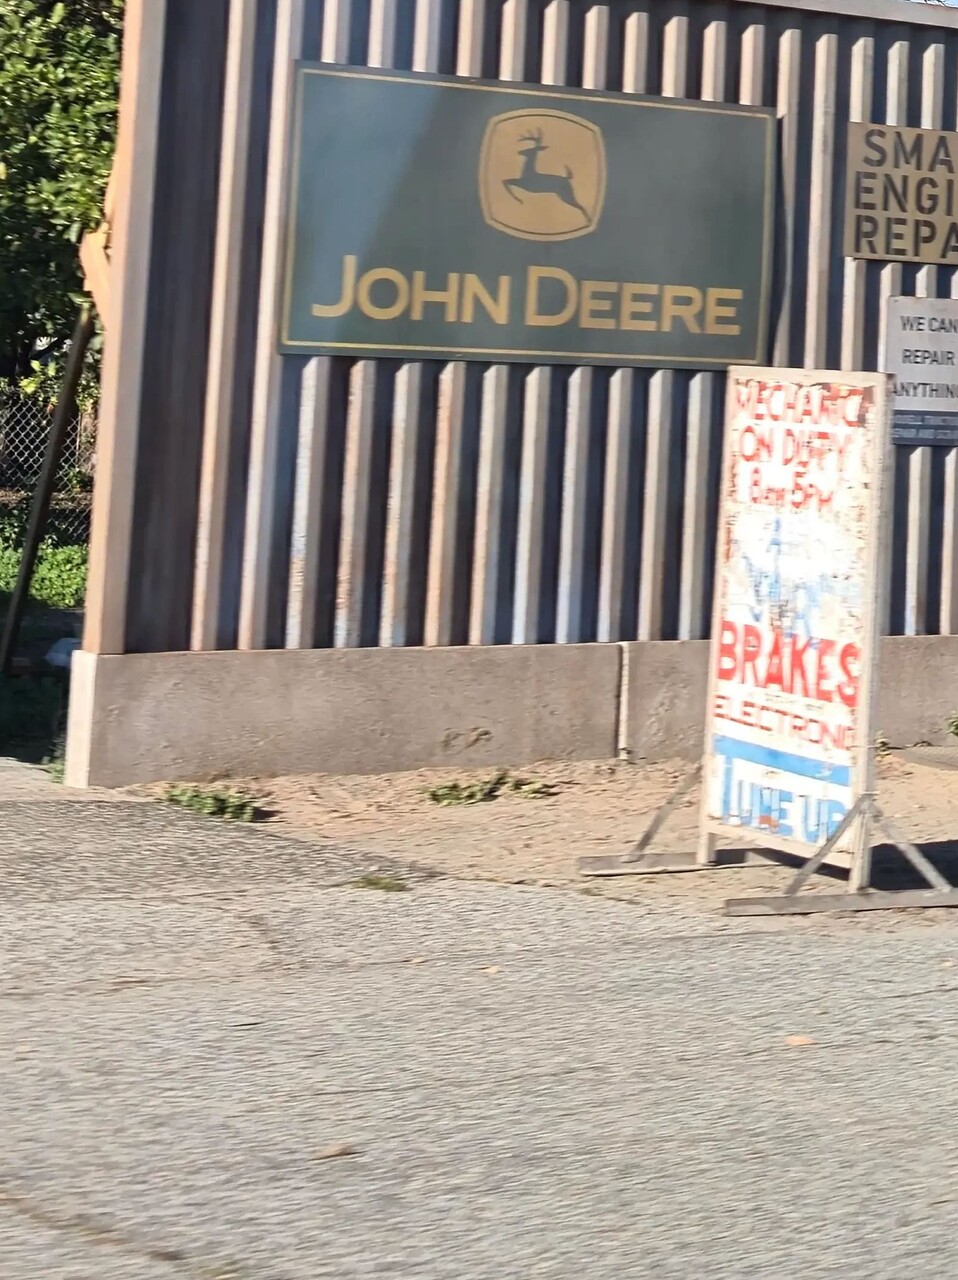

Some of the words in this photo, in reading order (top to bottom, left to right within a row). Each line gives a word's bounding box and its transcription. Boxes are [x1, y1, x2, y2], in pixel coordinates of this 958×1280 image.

[311, 254, 512, 325] JOHN
[525, 265, 743, 336] DEERE
[900, 316, 925, 331] WE
[928, 317, 958, 333] CAN
[902, 348, 955, 366] REPAIR
[717, 620, 862, 708] BRAKES
[800, 795, 848, 846] UP
